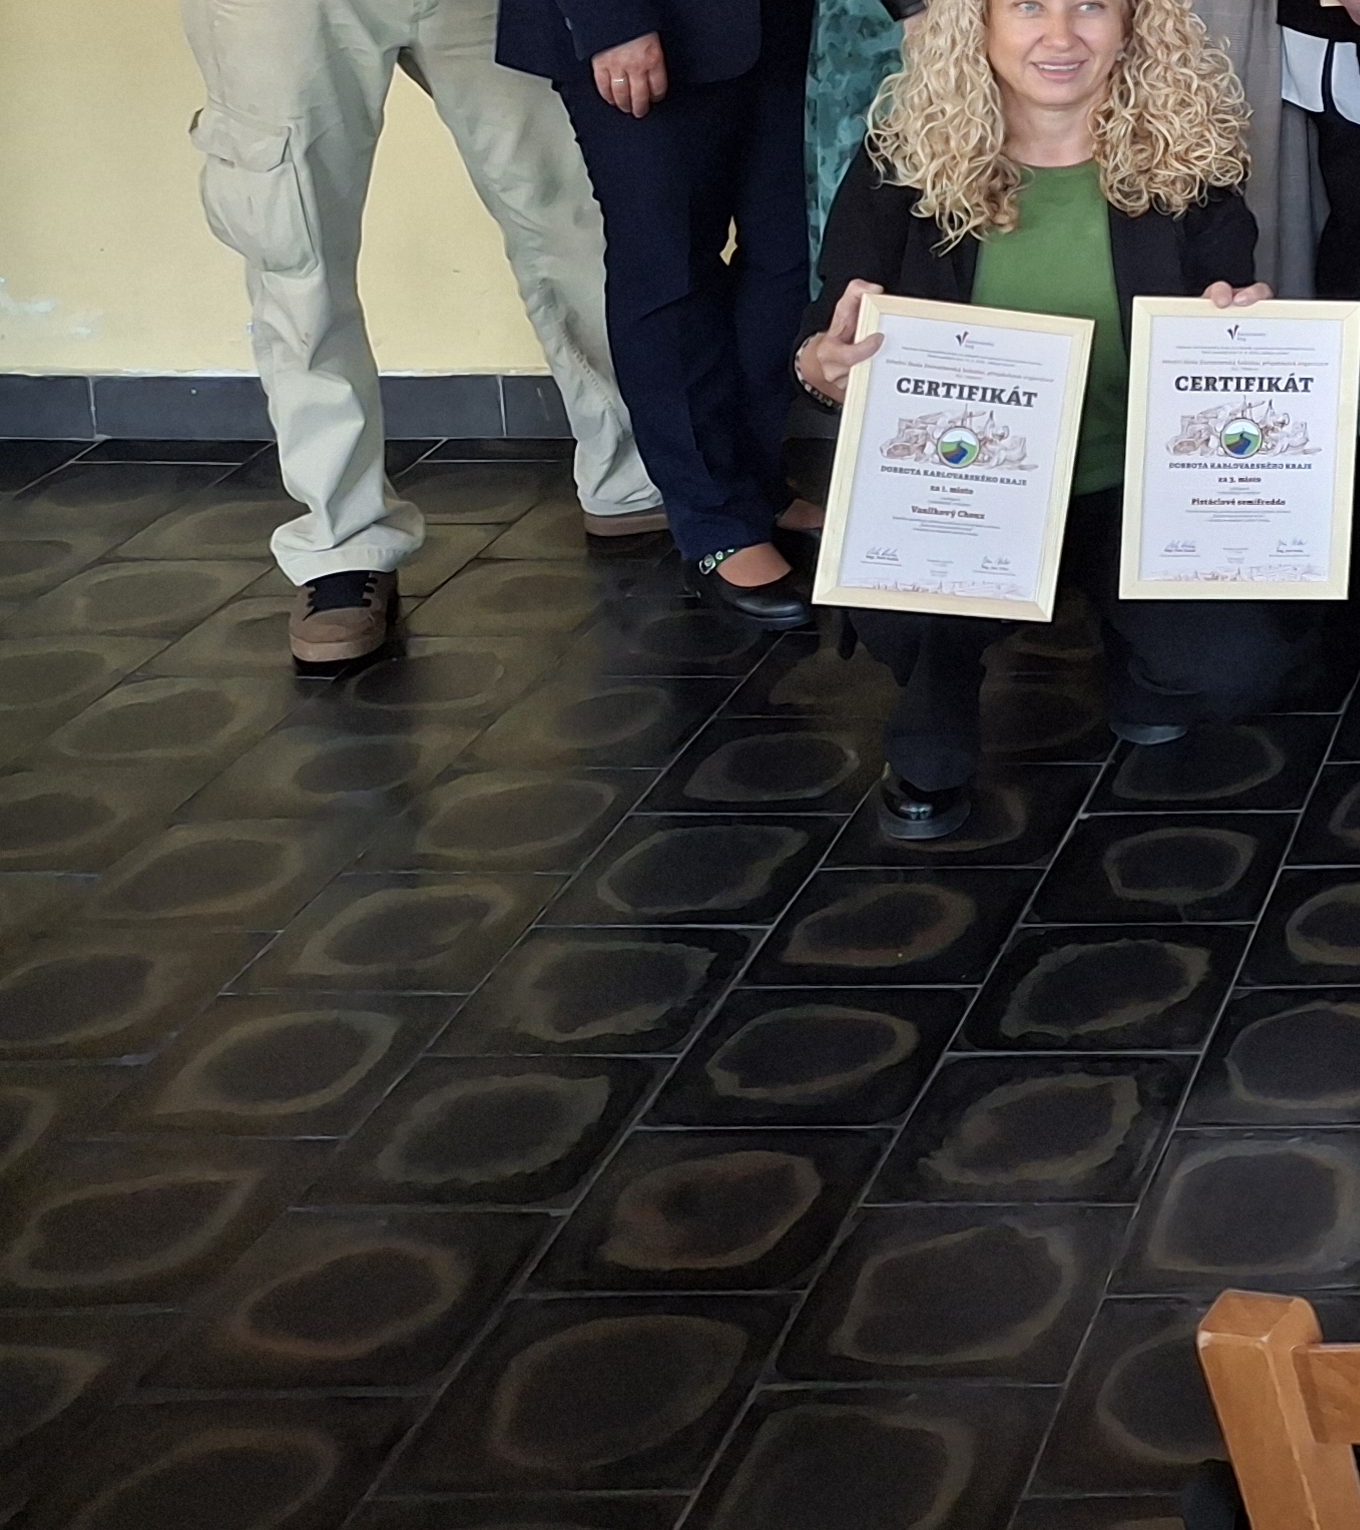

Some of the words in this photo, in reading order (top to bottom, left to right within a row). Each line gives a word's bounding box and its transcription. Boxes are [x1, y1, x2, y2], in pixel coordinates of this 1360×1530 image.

[1174, 373, 1314, 392] CERTIFIKÁT
[896, 378, 1038, 408] CERTIFIKÁT
[1237, 498, 1286, 506] semifreddo
